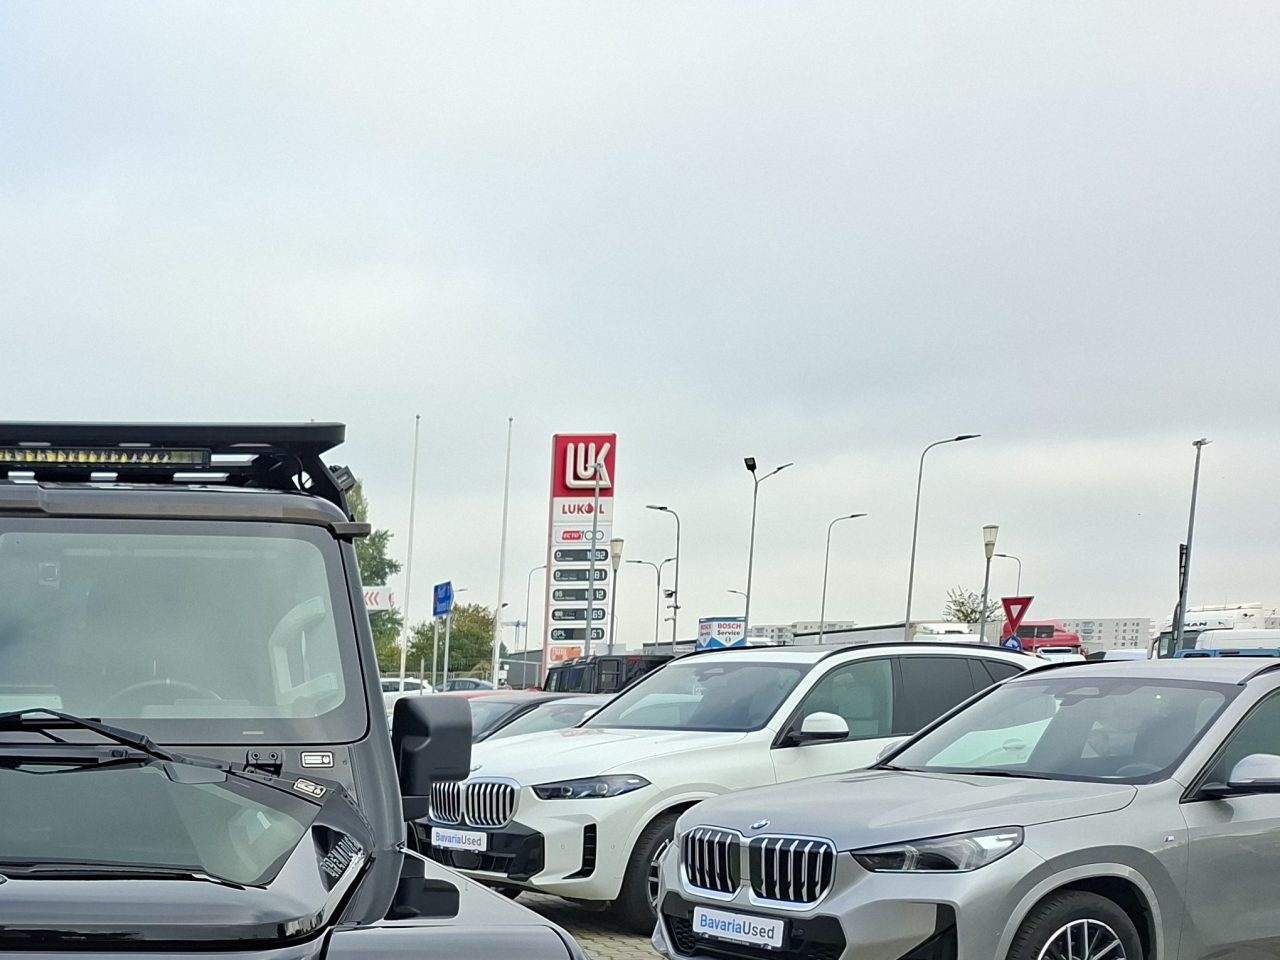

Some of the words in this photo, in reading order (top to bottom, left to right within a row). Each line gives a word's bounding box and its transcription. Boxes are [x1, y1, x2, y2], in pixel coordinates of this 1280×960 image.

[562, 503, 604, 514] LUKOL
[717, 622, 742, 630] BOSCH
[435, 832, 482, 846] BavariaUsed
[700, 914, 775, 939] BavariaUsed
